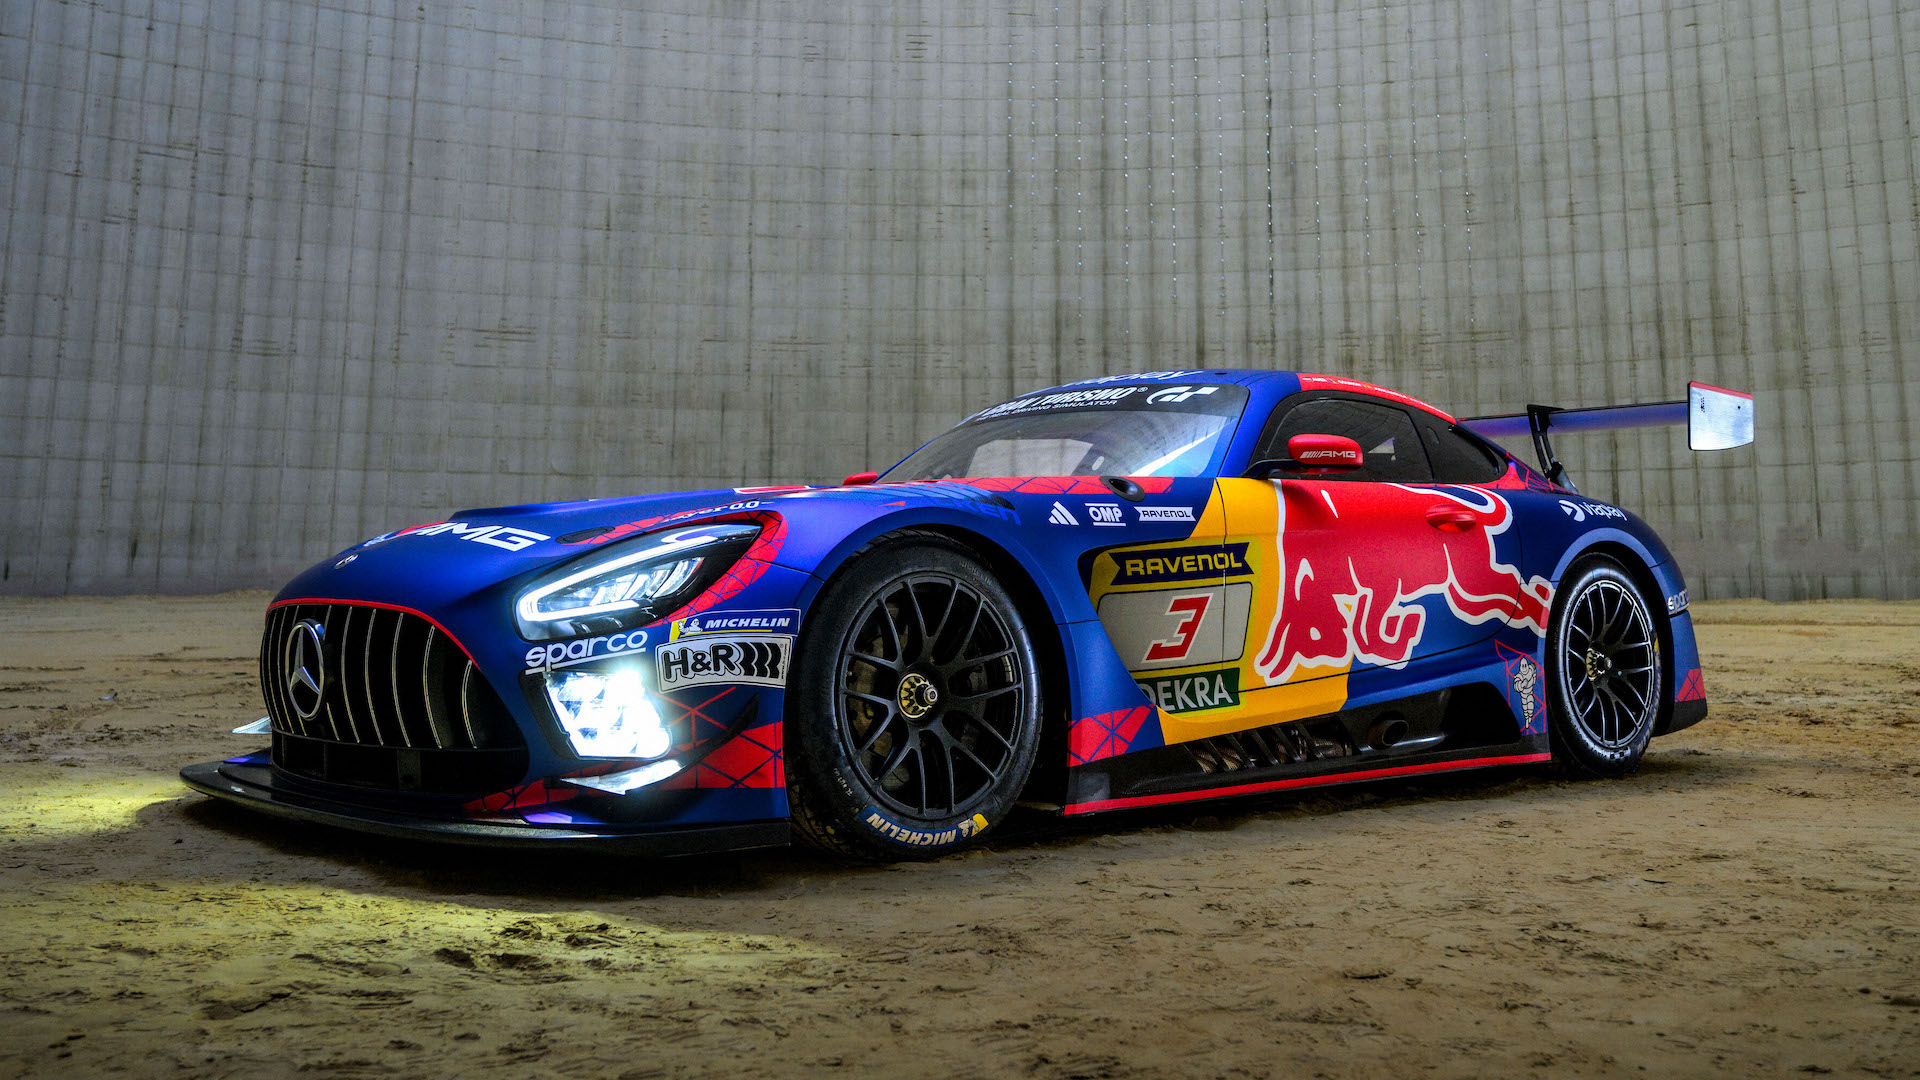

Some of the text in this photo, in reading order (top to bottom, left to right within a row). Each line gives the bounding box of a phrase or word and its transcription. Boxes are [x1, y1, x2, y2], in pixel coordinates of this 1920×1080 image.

[1052, 400, 1117, 409] SIMULATOR
[1319, 450, 1356, 458] AMG
[730, 501, 760, 510] 0.0
[1089, 503, 1123, 522] OMP
[1142, 510, 1191, 519] RAVENOL
[1579, 501, 1627, 521] viaplay
[416, 523, 551, 551] AMG
[1125, 552, 1242, 576] RAVENOL
[705, 617, 791, 629] MICHELIN
[1141, 593, 1213, 664] 3
[525, 631, 648, 672] sparco
[663, 643, 742, 683] H&R
[867, 812, 956, 846] MICHELIN
